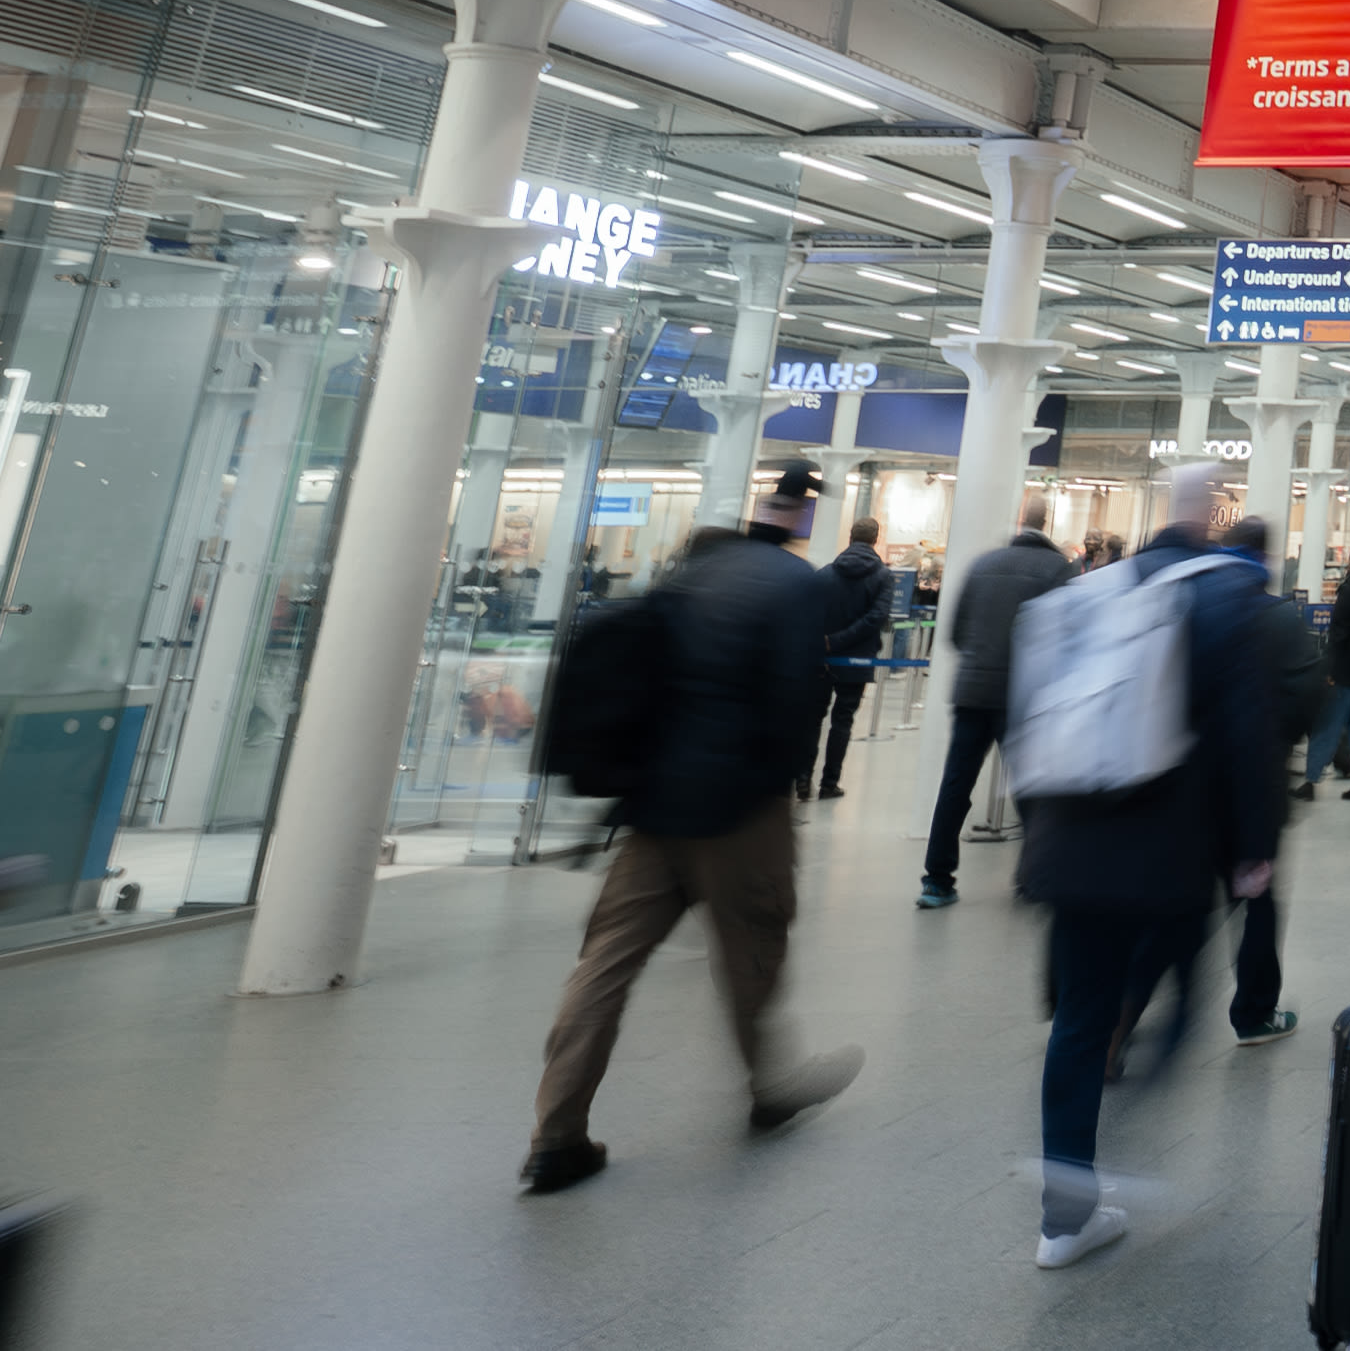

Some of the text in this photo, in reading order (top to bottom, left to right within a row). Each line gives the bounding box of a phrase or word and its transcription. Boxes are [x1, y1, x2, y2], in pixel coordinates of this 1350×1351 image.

[508, 179, 661, 257] ANGE
[512, 236, 631, 288] NEY
[1246, 243, 1330, 262] Departures
[1244, 269, 1341, 289] Underground
[1241, 295, 1336, 313] International
